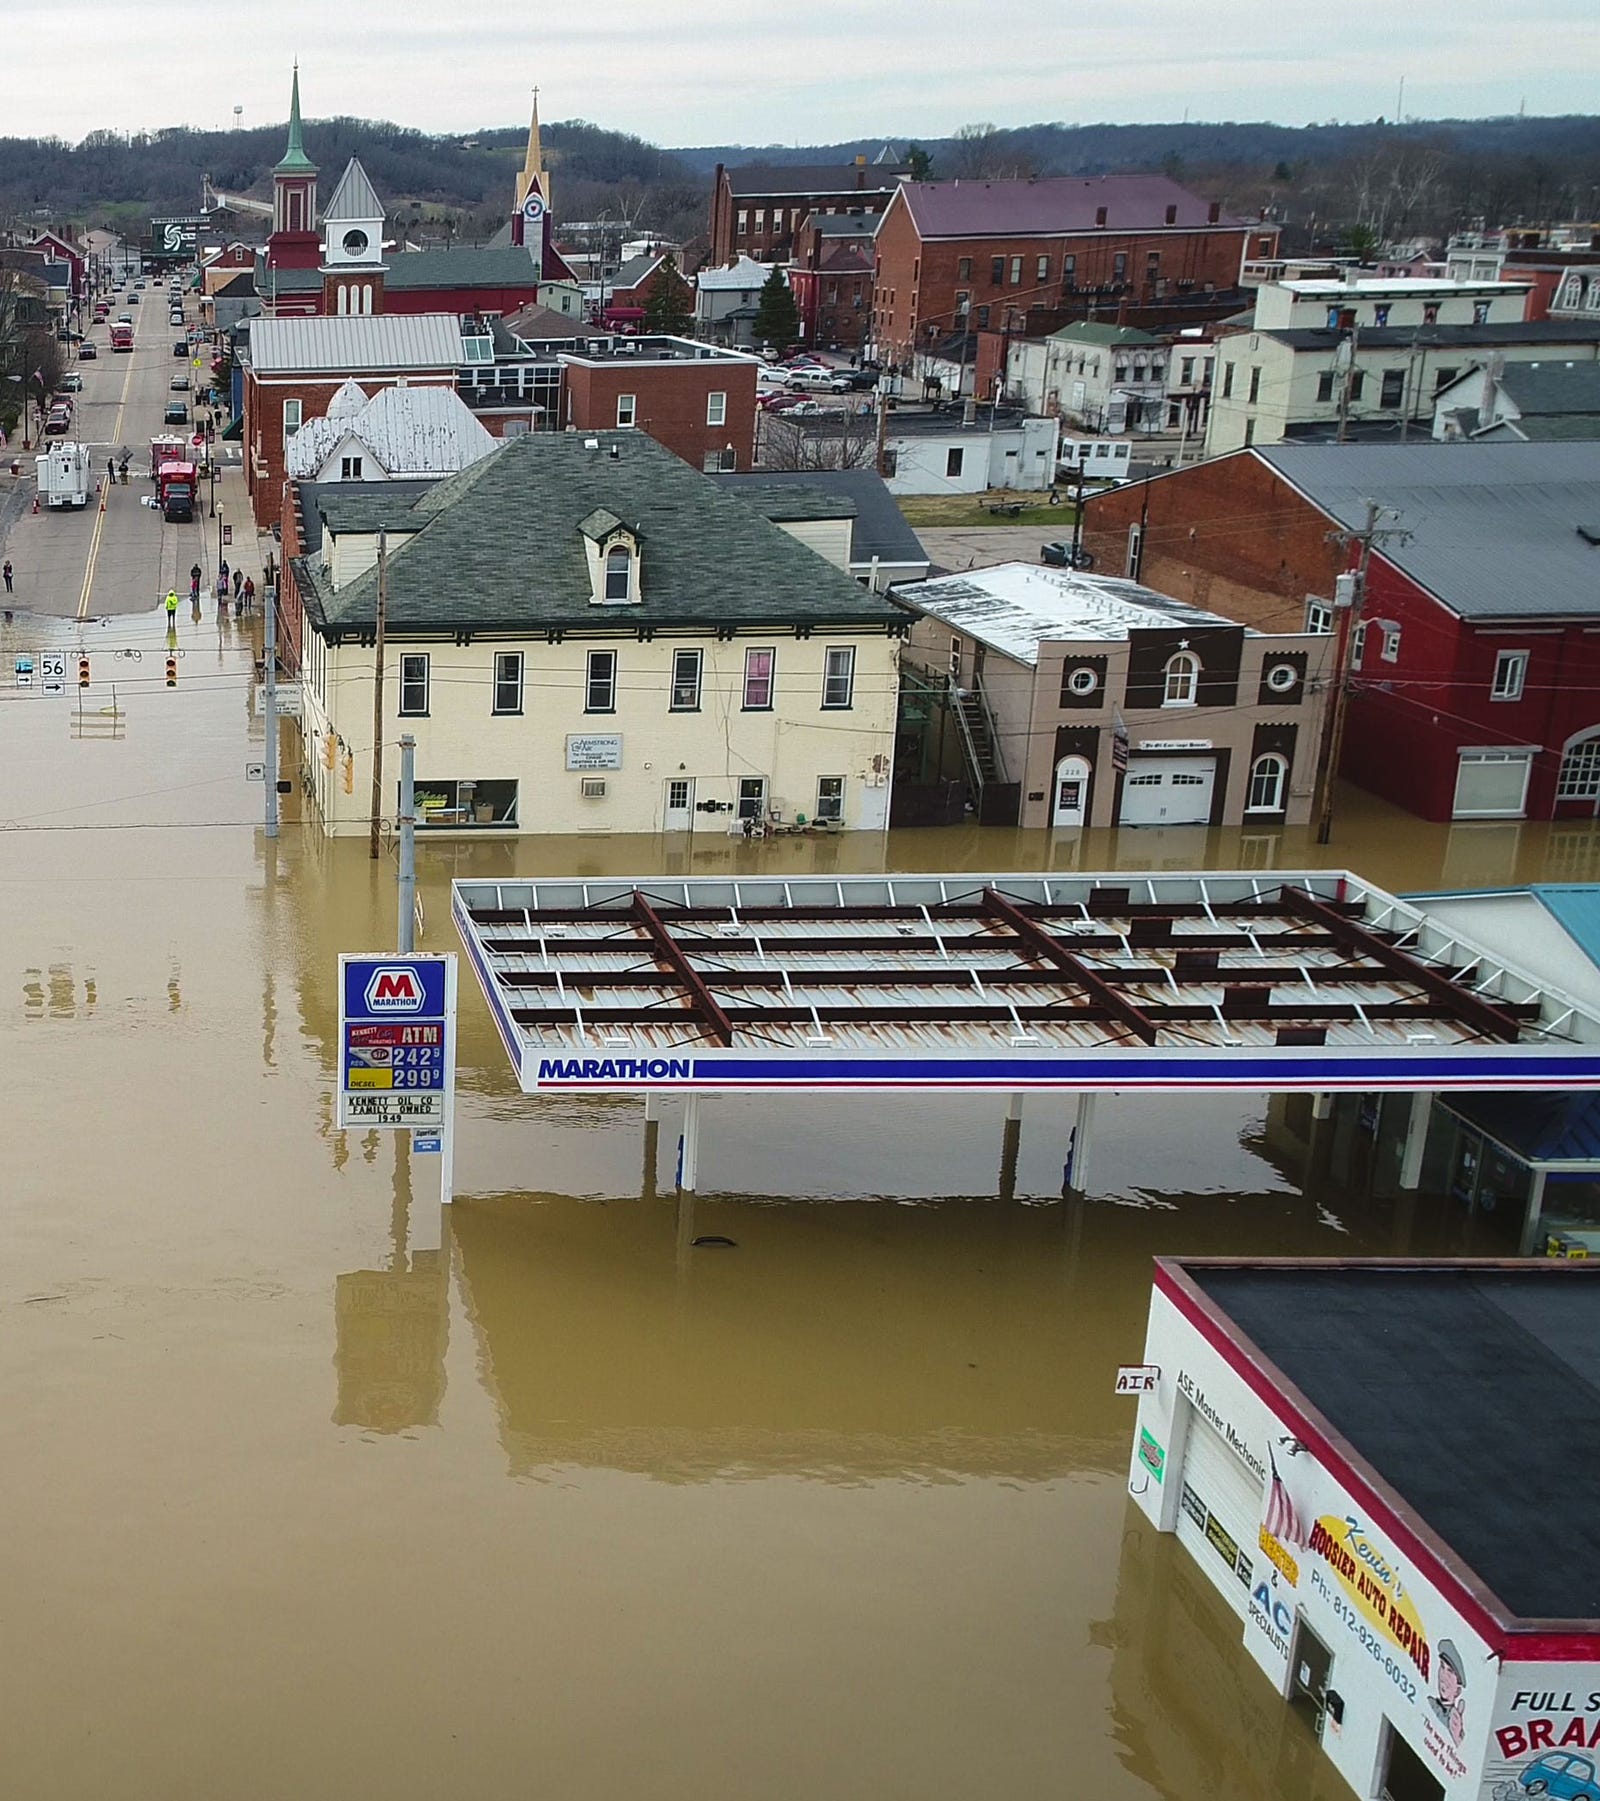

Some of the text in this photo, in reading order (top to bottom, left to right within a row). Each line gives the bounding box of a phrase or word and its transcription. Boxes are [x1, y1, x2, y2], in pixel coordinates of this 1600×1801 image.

[43, 661, 63, 675] 56
[375, 974, 415, 997] M
[373, 998, 417, 1007] MARATHON
[401, 1026, 438, 1044] ATM
[538, 1059, 690, 1079] MARATHON
[349, 1096, 433, 1106] KENNETT OIL CO
[353, 1105, 431, 1115] FAMILY OWNED
[378, 1115, 402, 1123] 1949
[1116, 1375, 1155, 1391] AIR
[1177, 1369, 1267, 1481] ASE Master Mechanic
[1270, 1569, 1279, 1588] &
[1252, 1580, 1292, 1636] AC
[1308, 1519, 1431, 1685] HOOSIER AUTO REPAIR
[1248, 1600, 1289, 1661] SPECIALISTS
[1311, 1569, 1418, 1705] Ph: 812-926-6032
[1511, 1692, 1575, 1712] FULL
